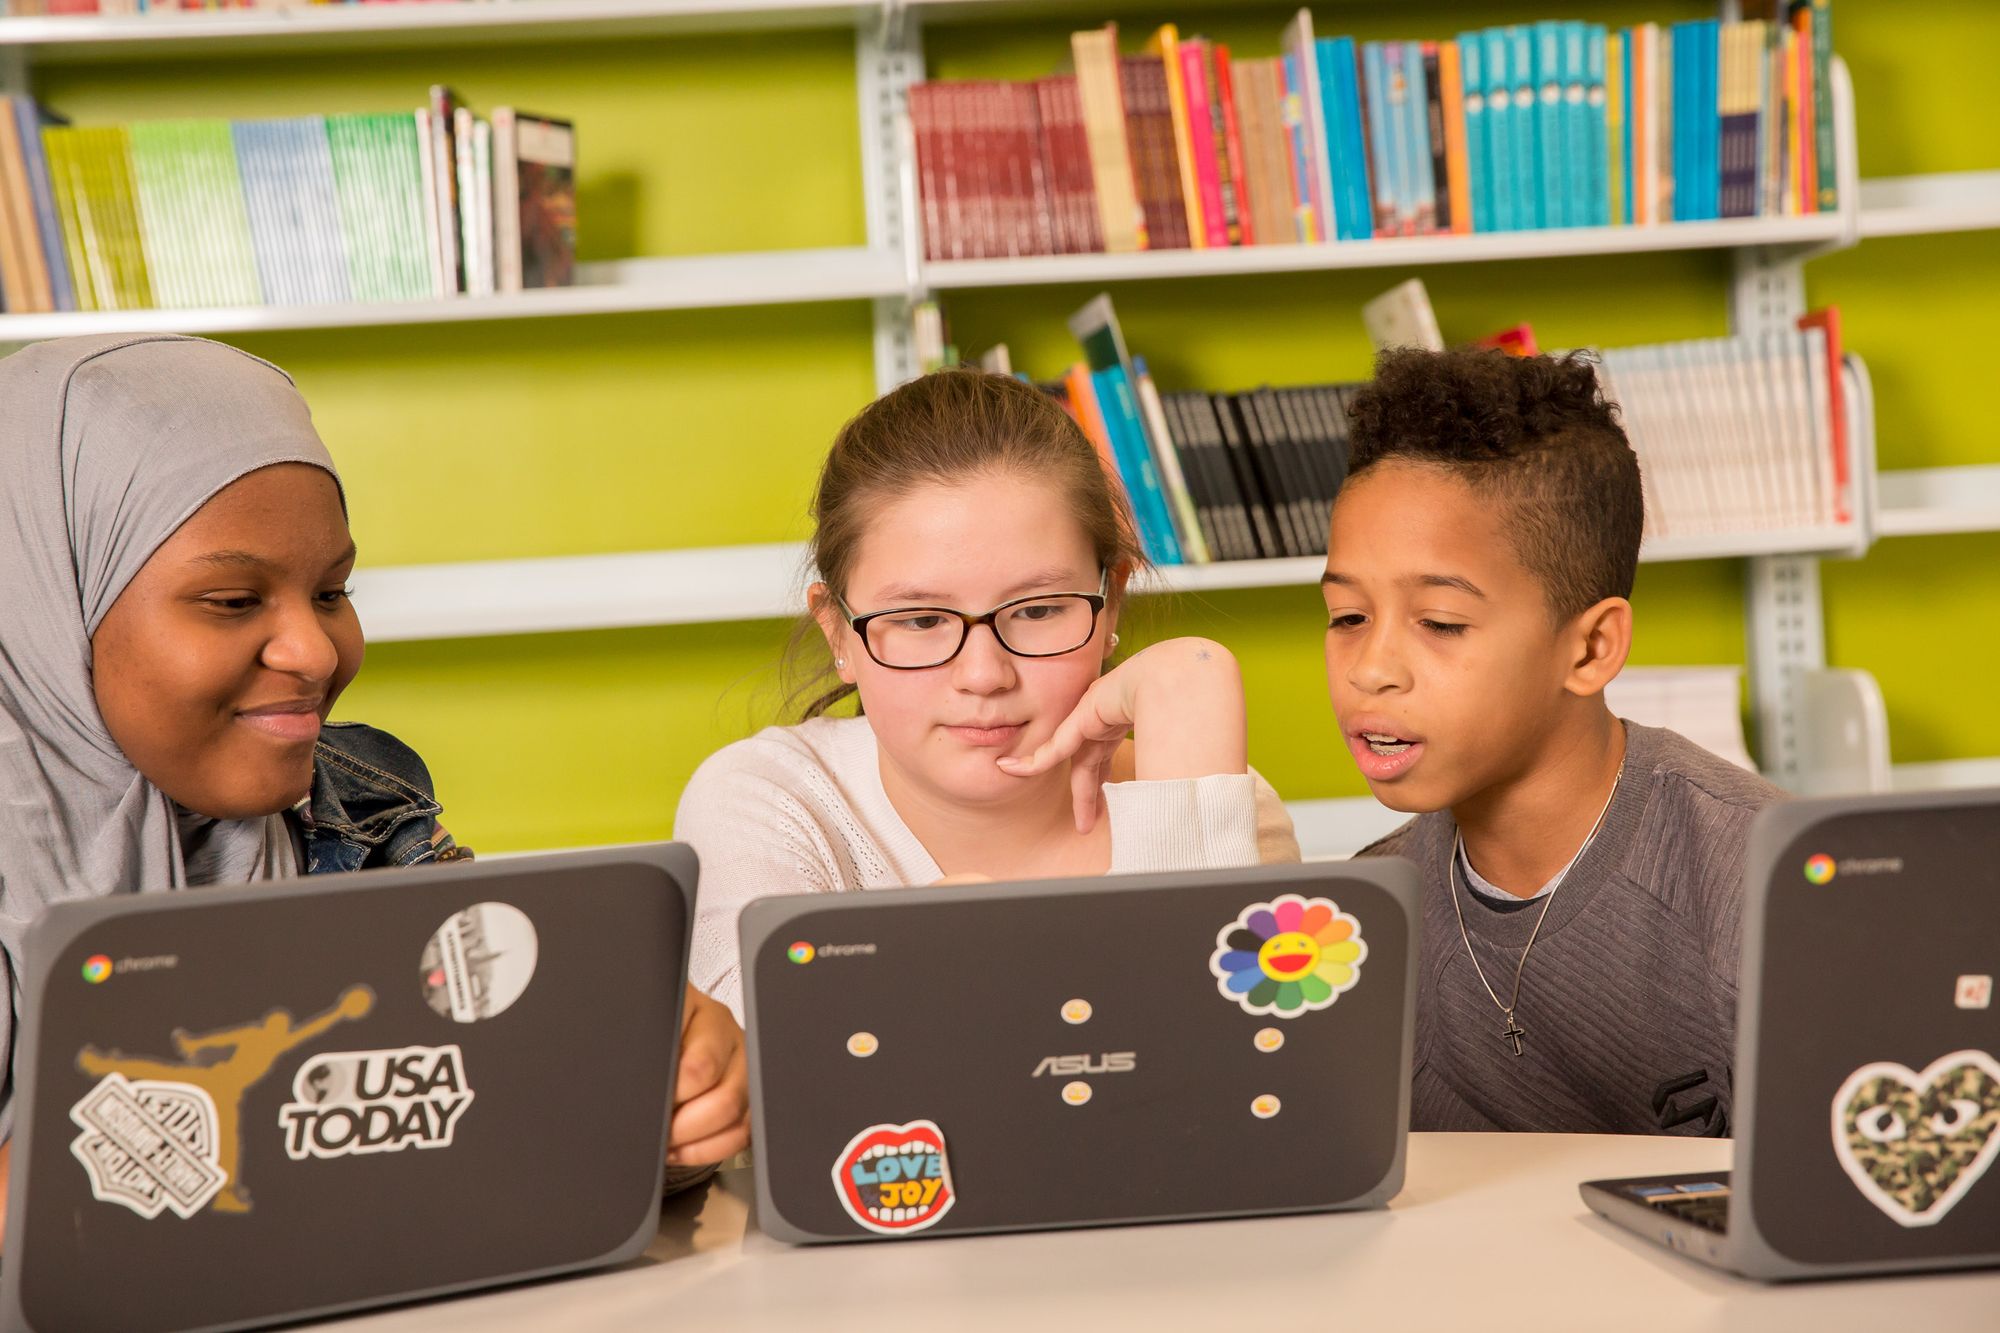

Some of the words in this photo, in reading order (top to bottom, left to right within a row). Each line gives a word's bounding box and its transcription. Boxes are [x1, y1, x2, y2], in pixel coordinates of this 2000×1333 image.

[115, 955, 178, 974] chrome
[817, 943, 877, 958] chrome
[356, 1054, 459, 1101] USA
[1031, 1052, 1136, 1077] ASUS
[288, 1098, 464, 1152] TODAY
[851, 1154, 942, 1185] LOVE
[879, 1178, 943, 1208] JOY
